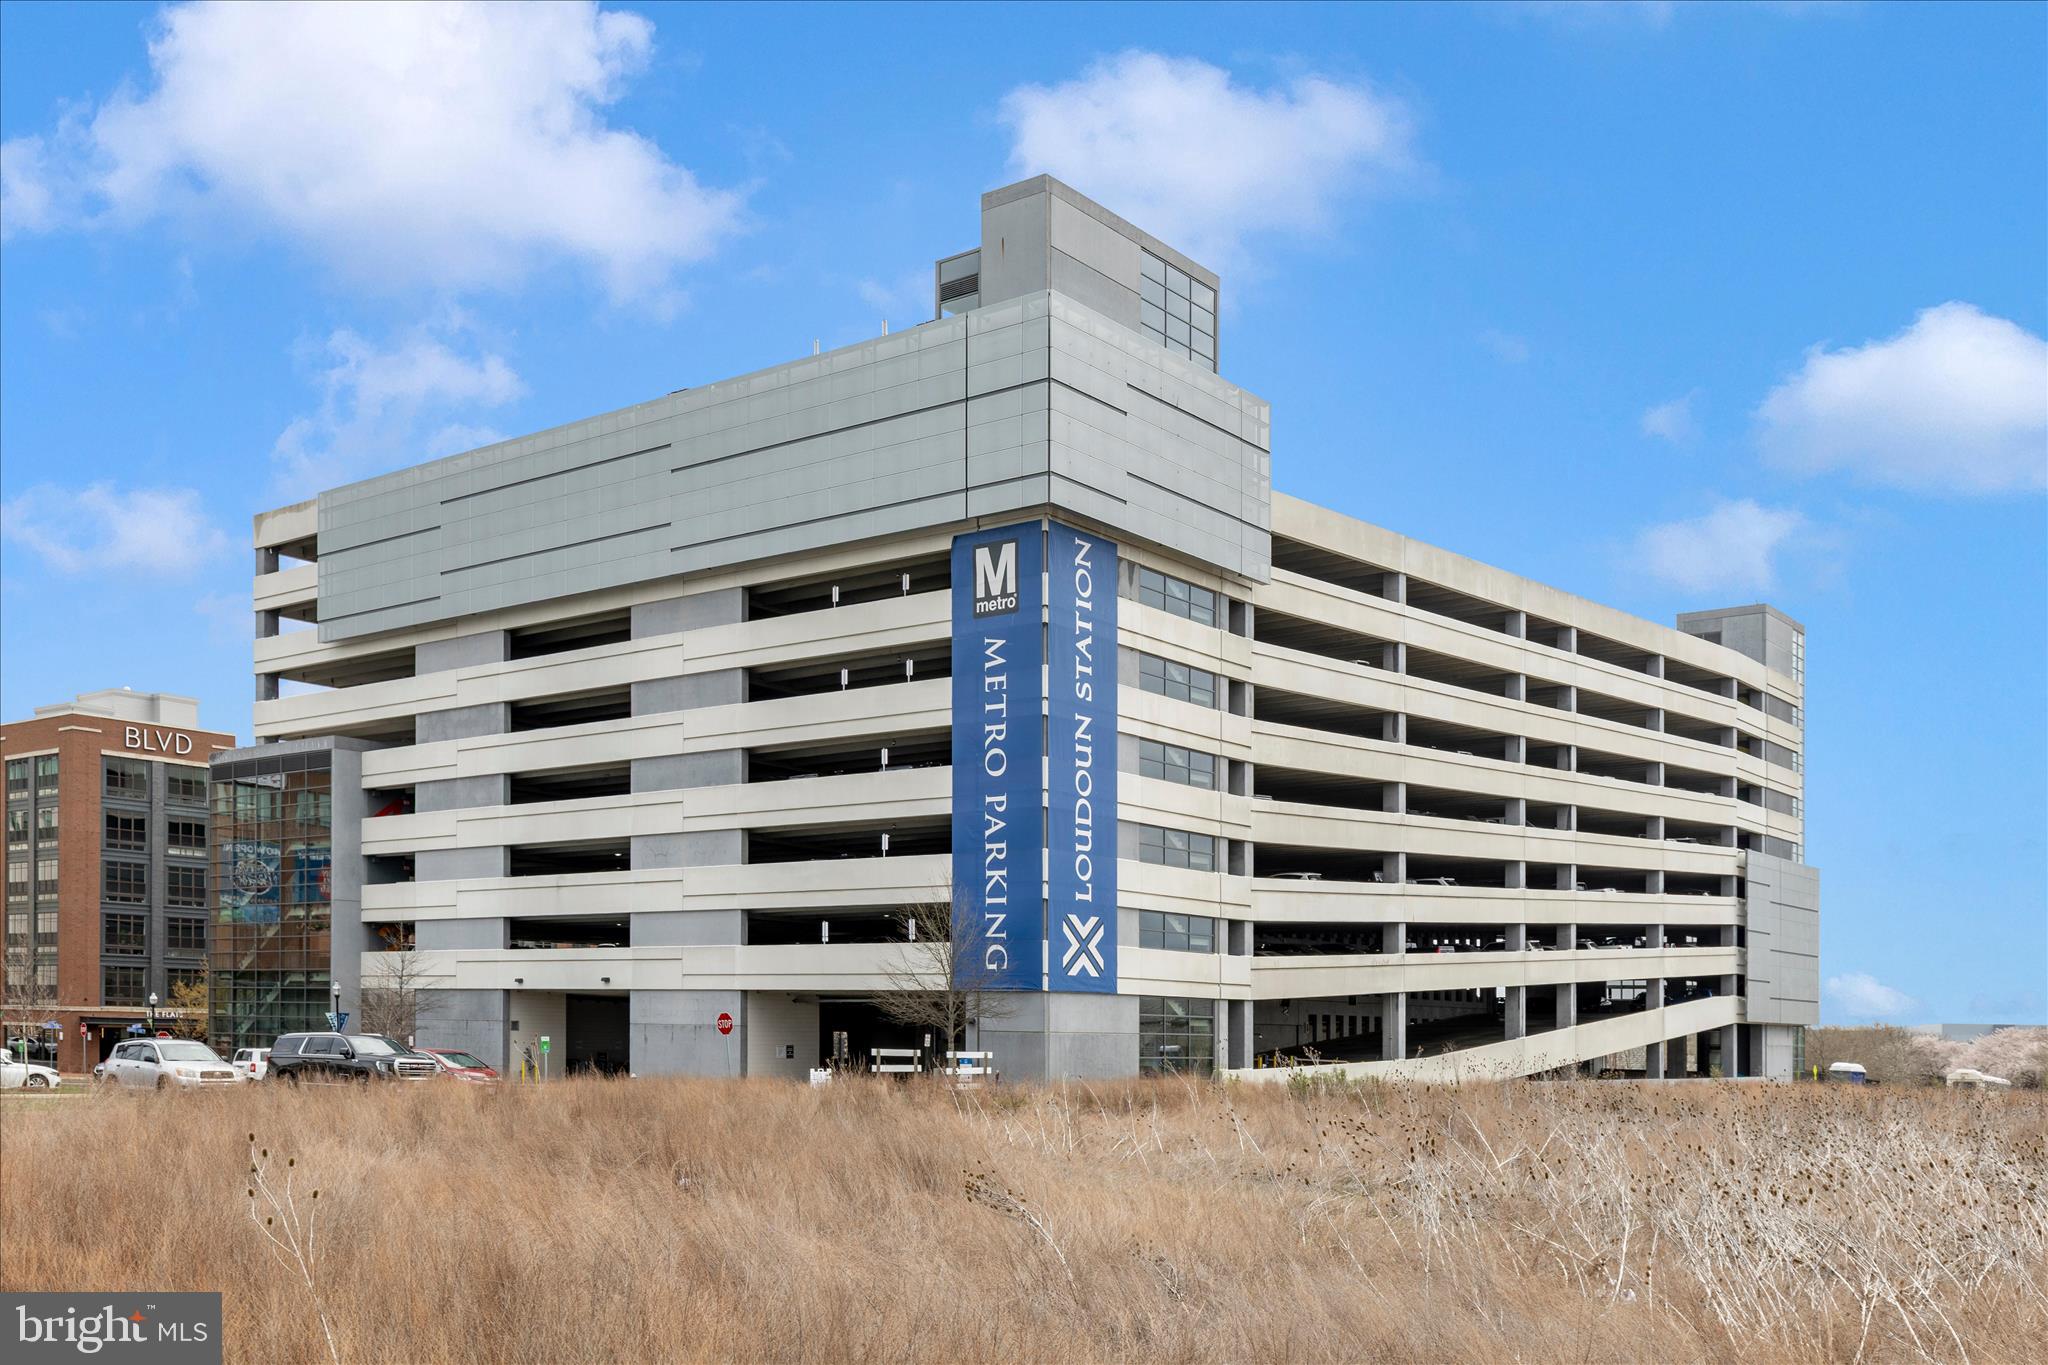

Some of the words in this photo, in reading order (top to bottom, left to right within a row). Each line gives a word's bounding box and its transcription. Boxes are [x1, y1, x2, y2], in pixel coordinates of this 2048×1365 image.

[976, 542, 1016, 598] M
[976, 596, 1016, 613] metro
[1075, 537, 1092, 702] STATION
[125, 726, 193, 754] BLVD
[984, 637, 1007, 777] METRO
[1075, 712, 1093, 903] LOUDOUN
[984, 793, 1008, 973] PARKING
[718, 1019, 732, 1029] STOP
